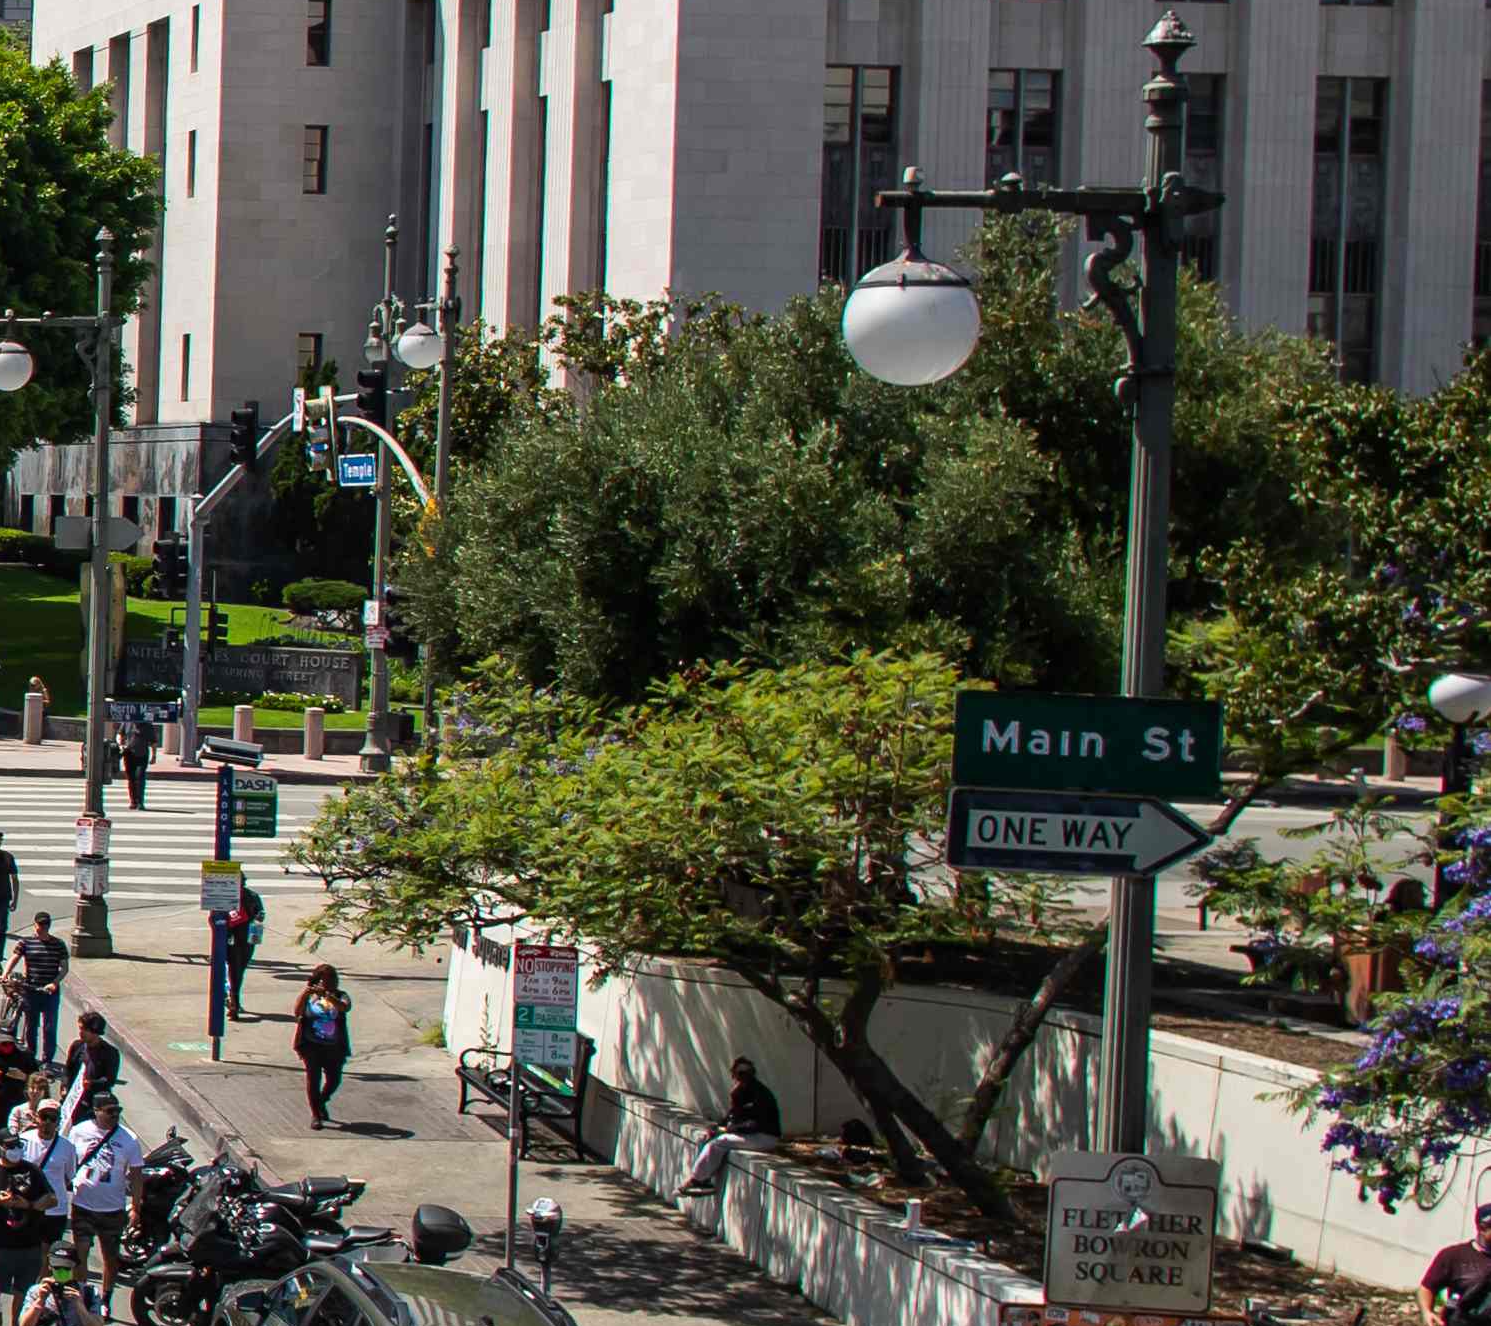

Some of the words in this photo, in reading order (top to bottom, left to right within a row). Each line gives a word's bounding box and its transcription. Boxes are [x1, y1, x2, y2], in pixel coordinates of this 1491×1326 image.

[342, 462, 373, 480] Temple
[982, 719, 1103, 758] Main
[1142, 725, 1194, 762] St
[235, 778, 273, 792] DASH
[978, 816, 1046, 846] ONE
[1063, 819, 1134, 850] WAY
[516, 957, 534, 973] NO
[535, 958, 575, 973] STOPPING
[518, 1007, 528, 1021] 2
[1063, 1208, 1204, 1235] FLETHER
[1075, 1263, 1184, 1286] SQUARE
